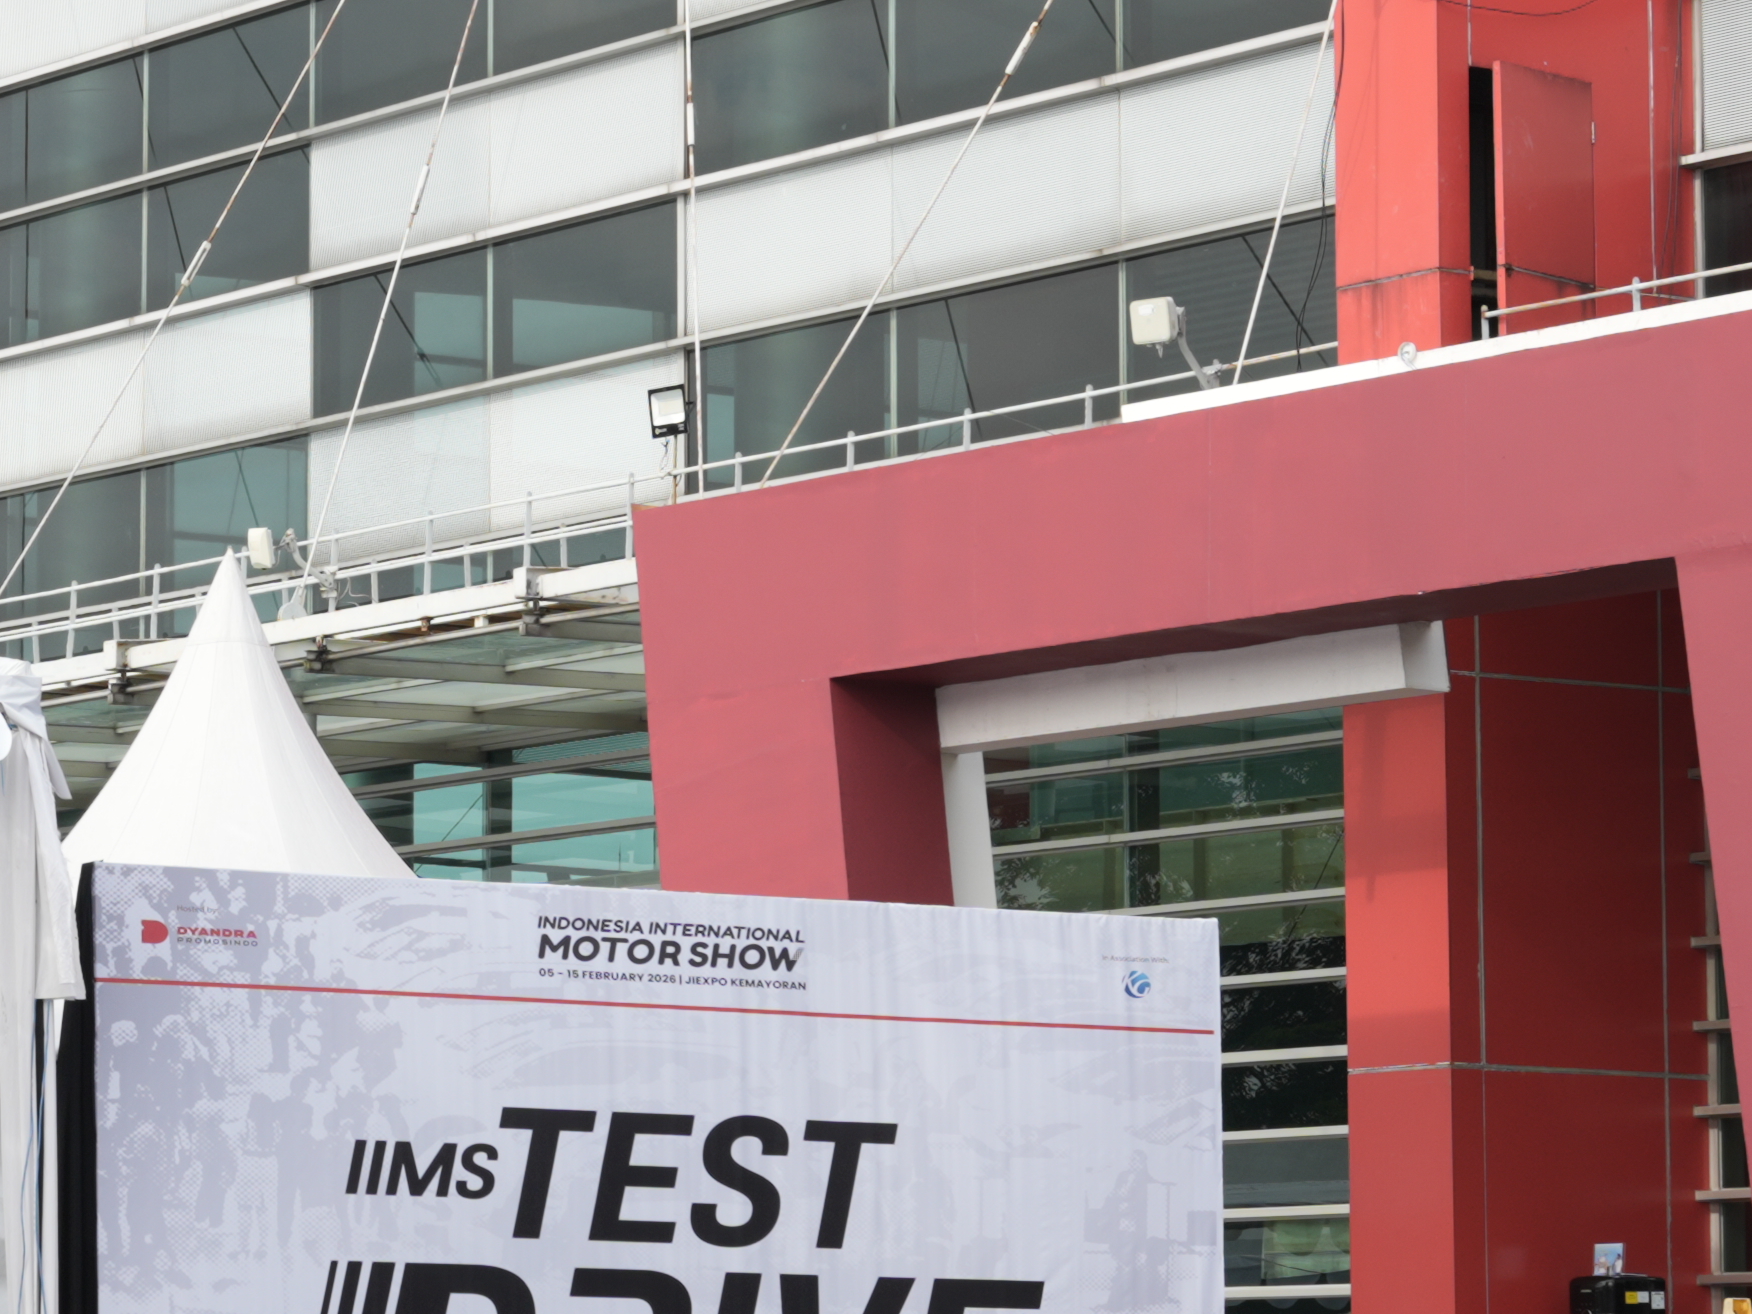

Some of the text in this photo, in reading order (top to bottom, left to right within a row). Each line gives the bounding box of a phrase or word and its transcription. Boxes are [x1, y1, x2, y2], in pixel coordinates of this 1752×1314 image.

[177, 926, 258, 939] DYANDRA
[177, 936, 259, 948] PROMOSINDO
[537, 916, 806, 944] INDONESIA INTERNATIONAL
[538, 933, 804, 973] MOTOR SHOW
[539, 967, 555, 978] 05
[566, 969, 580, 979] 15
[582, 970, 645, 982] FEBRUARY
[647, 973, 677, 985] 2026
[685, 975, 728, 987] JIEXPO
[730, 977, 807, 991] KEMAYORAN
[498, 1106, 899, 1250] TEST
